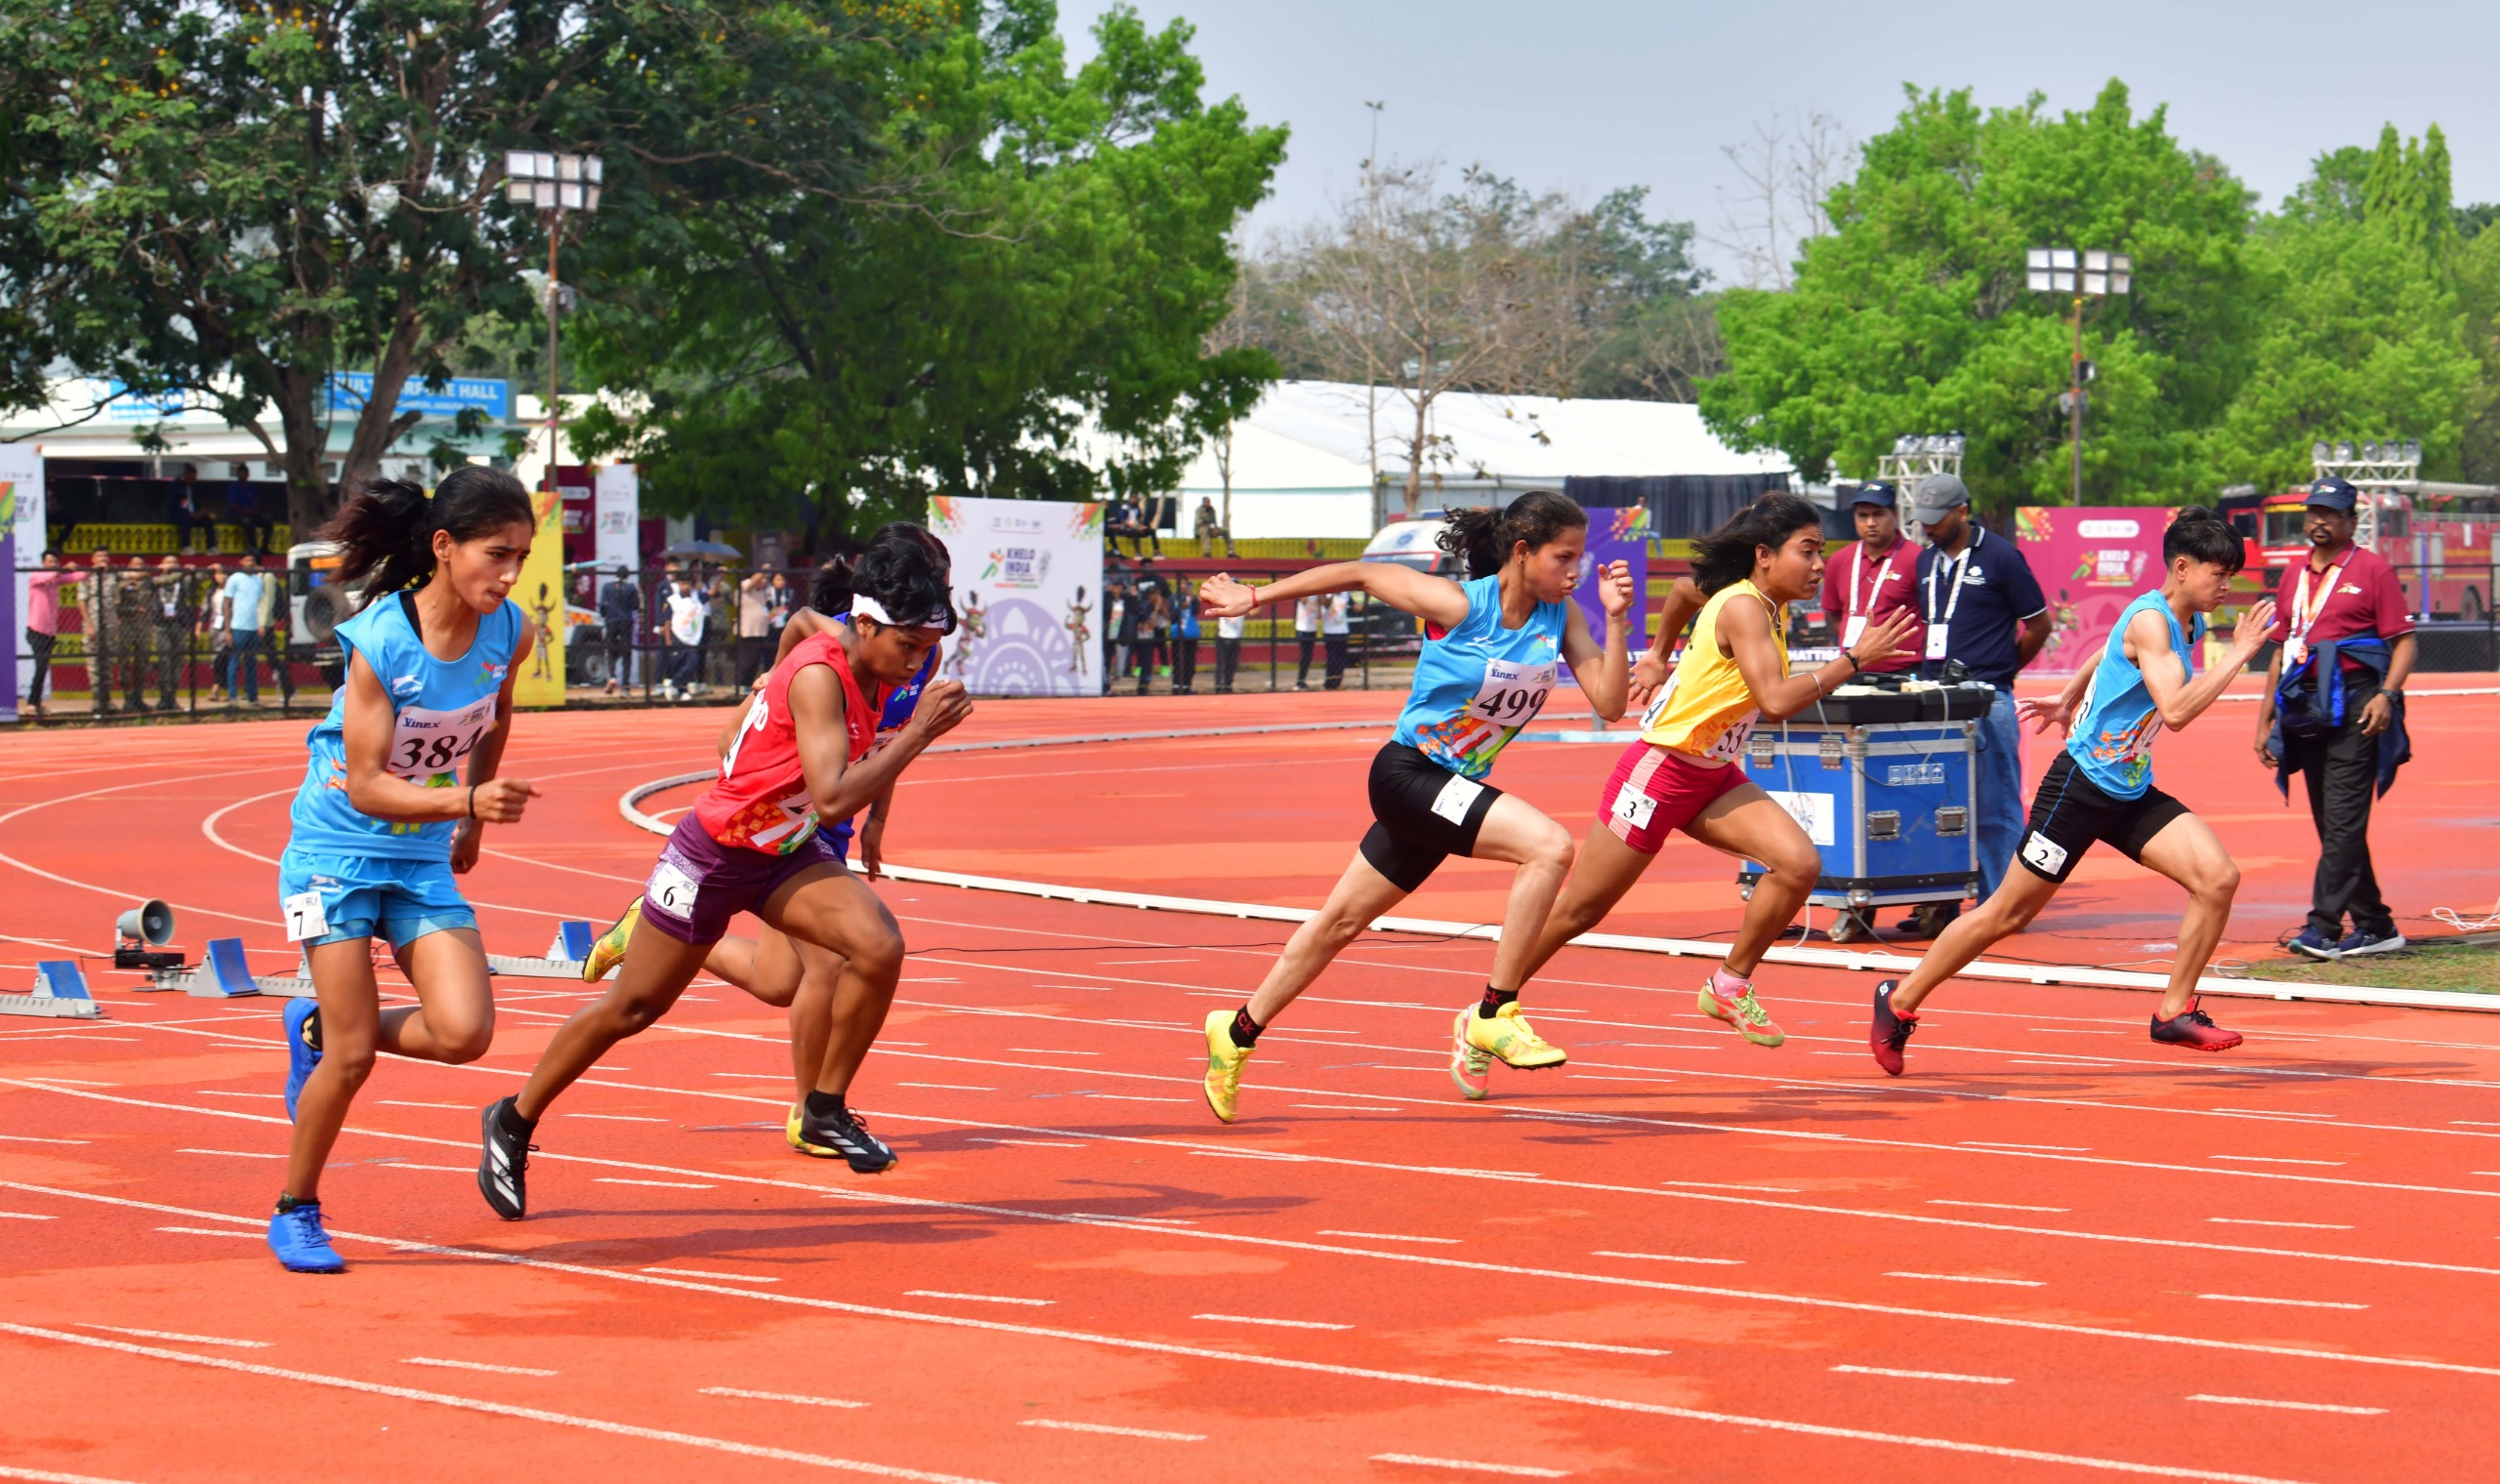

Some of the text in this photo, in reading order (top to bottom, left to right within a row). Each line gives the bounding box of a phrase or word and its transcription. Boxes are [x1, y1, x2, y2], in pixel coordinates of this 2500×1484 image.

[459, 384, 498, 399] HALL
[1490, 668, 1520, 680] Vinex
[402, 717, 441, 729] Vinex
[390, 724, 483, 769] 384
[1623, 801, 1637, 818] 3
[2034, 849, 2049, 866] 2
[663, 886, 678, 907] 6
[293, 911, 304, 936] 7
